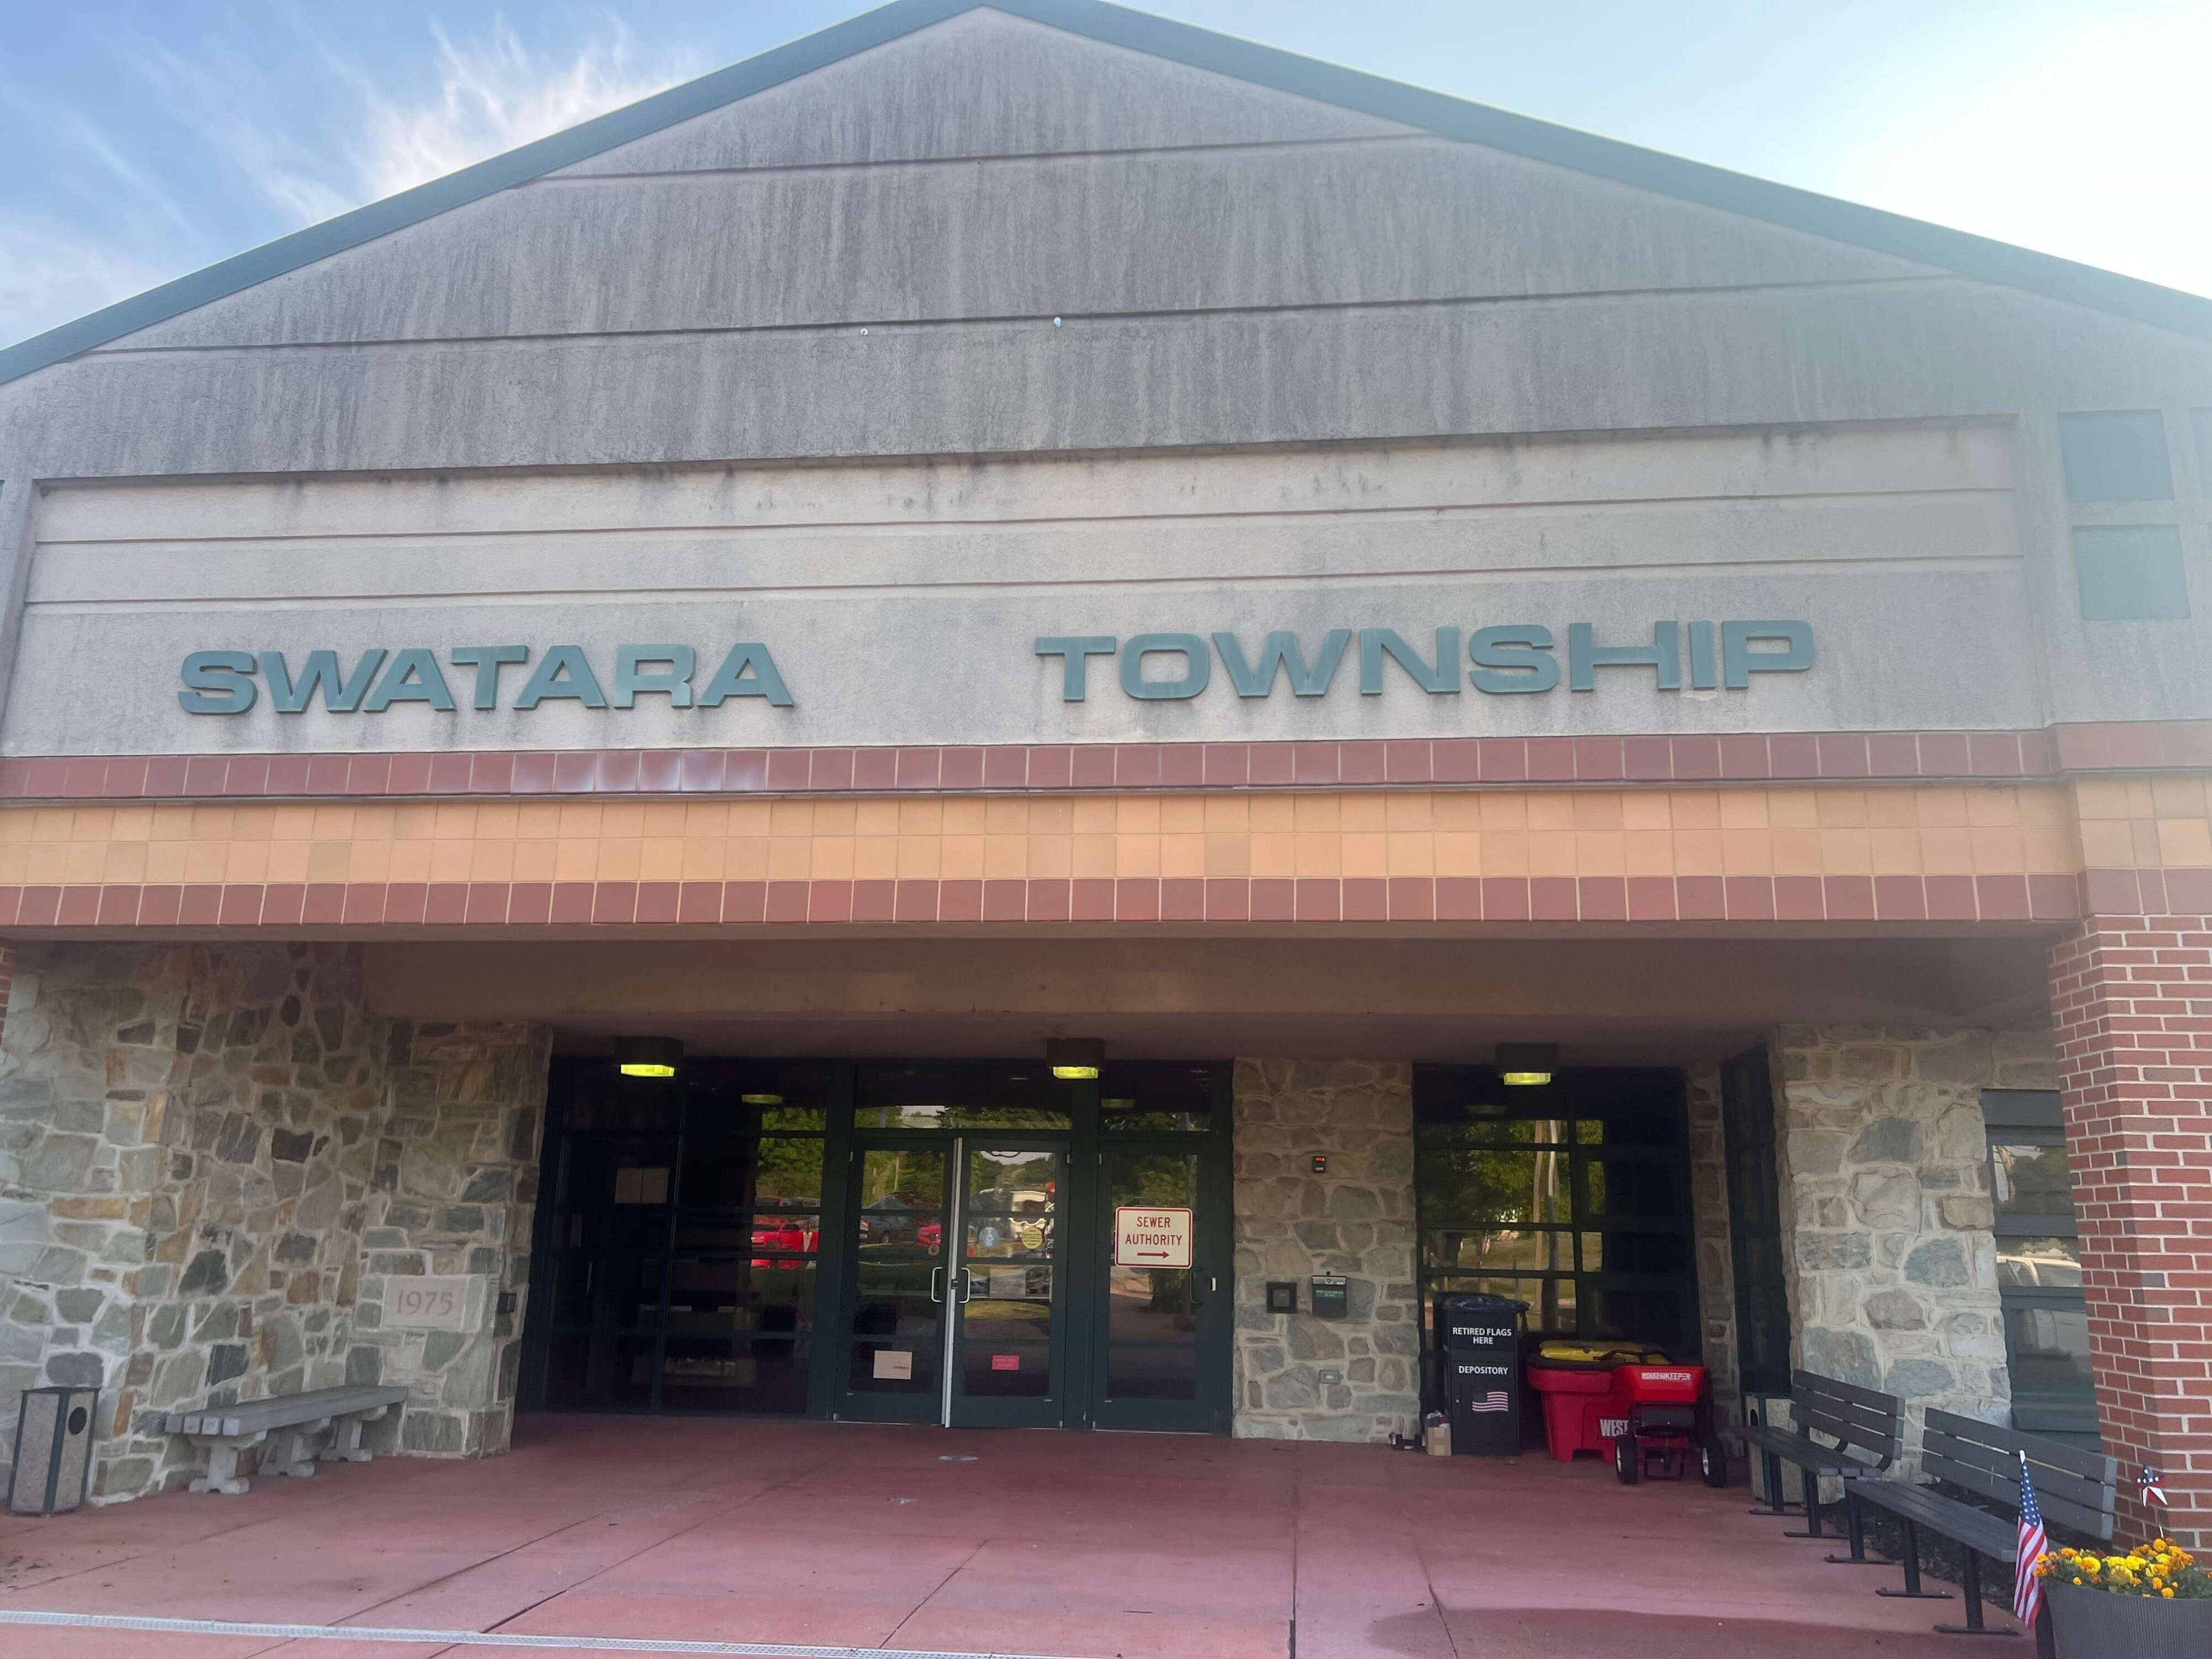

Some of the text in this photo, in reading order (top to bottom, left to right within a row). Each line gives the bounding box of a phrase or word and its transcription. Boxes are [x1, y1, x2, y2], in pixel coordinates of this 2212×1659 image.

[178, 620, 1815, 715] SWATARA TOWNSHIP
[1137, 1216, 1170, 1228] SEWER
[1125, 1233, 1182, 1246] AUTHORITY
[396, 1287, 453, 1315] 1975
[1453, 1327, 1485, 1335] RETIRED
[1458, 1366, 1508, 1375] DEPOSITORY
